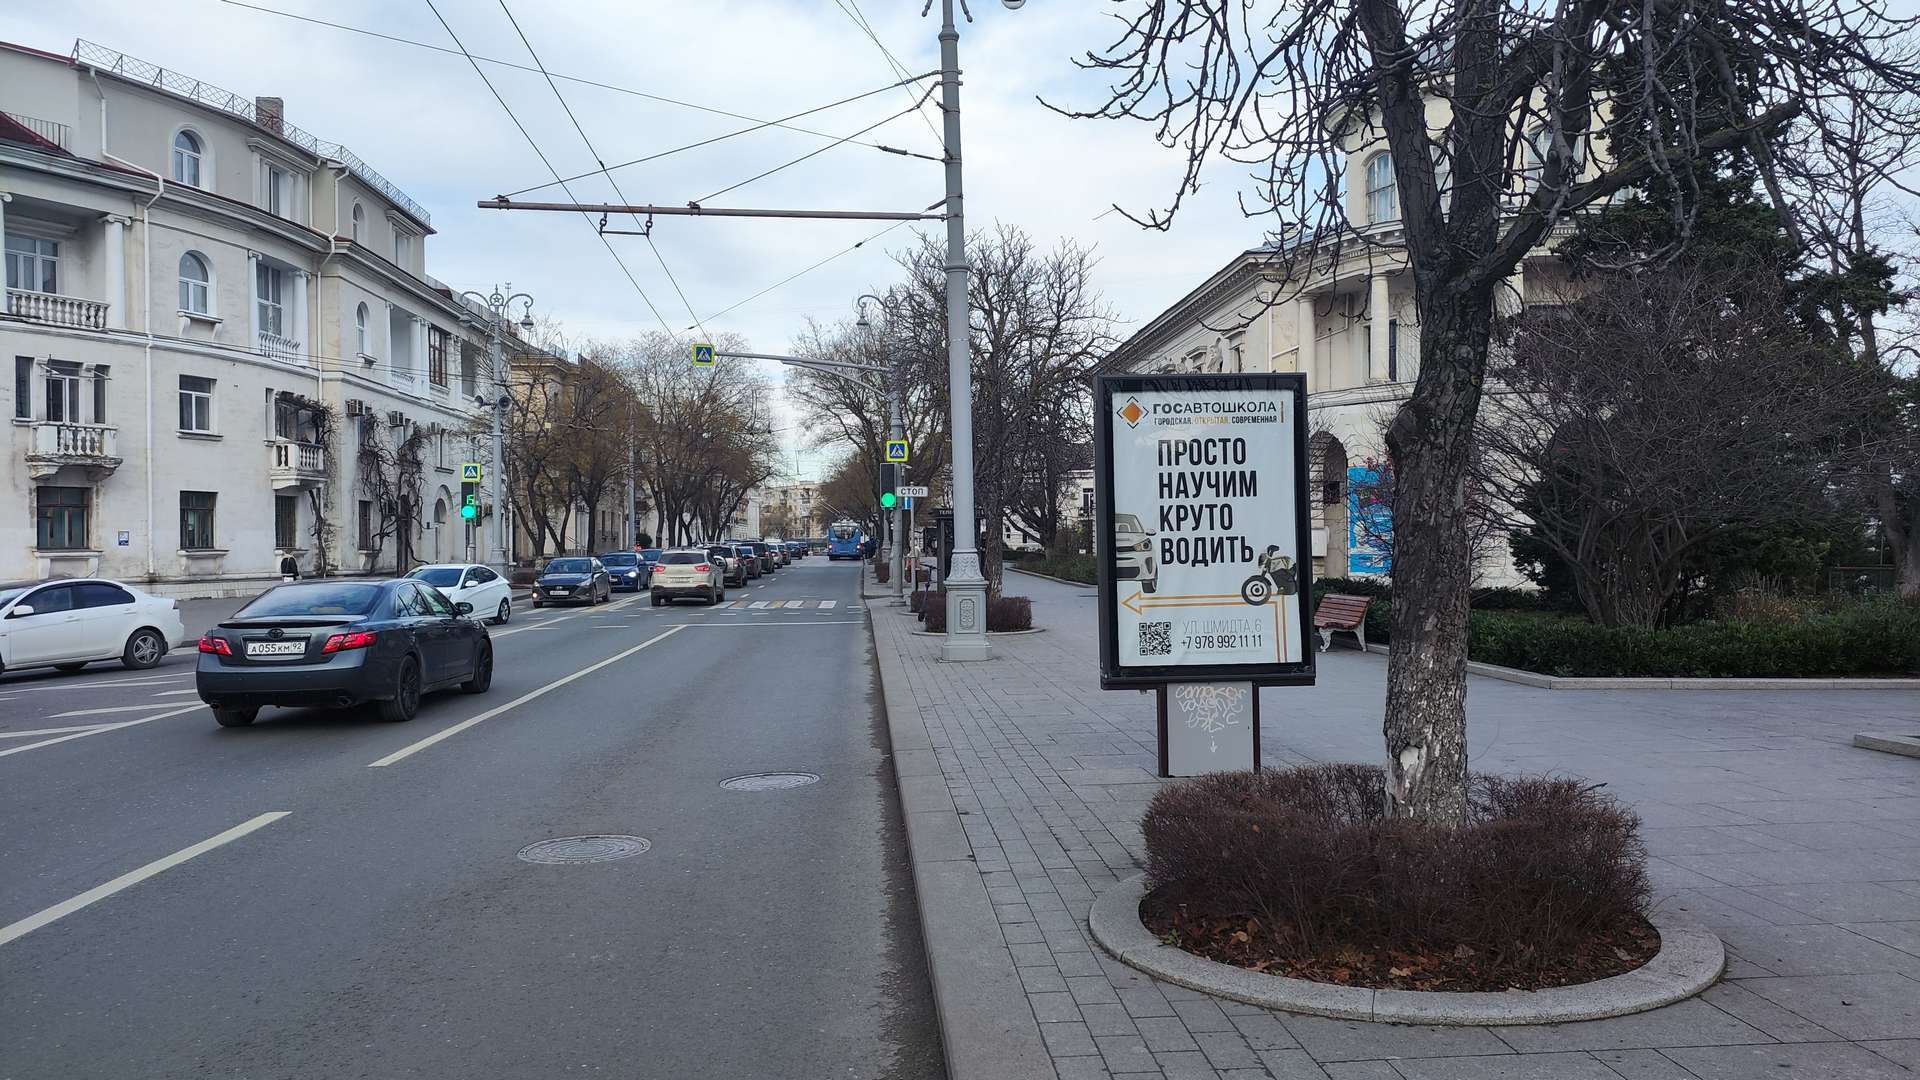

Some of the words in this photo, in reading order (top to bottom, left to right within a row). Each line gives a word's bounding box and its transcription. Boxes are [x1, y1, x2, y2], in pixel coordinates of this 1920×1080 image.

[1153, 401, 1277, 414] ГОСАВТОШКОЛА
[1231, 415, 1278, 424] СОВРЕМЕННАЯ
[1158, 437, 1246, 466] ПРОСТО
[900, 487, 924, 495] СТОП
[1159, 470, 1257, 499] НАУЧИМ
[1160, 503, 1233, 532] КРУТО
[1161, 536, 1254, 567] ВОДИТЬ
[1181, 636, 1192, 649] +7
[1194, 635, 1214, 649] 978
[1217, 634, 1236, 648] 992
[1239, 634, 1249, 648] 11
[1253, 634, 1262, 647] 11
